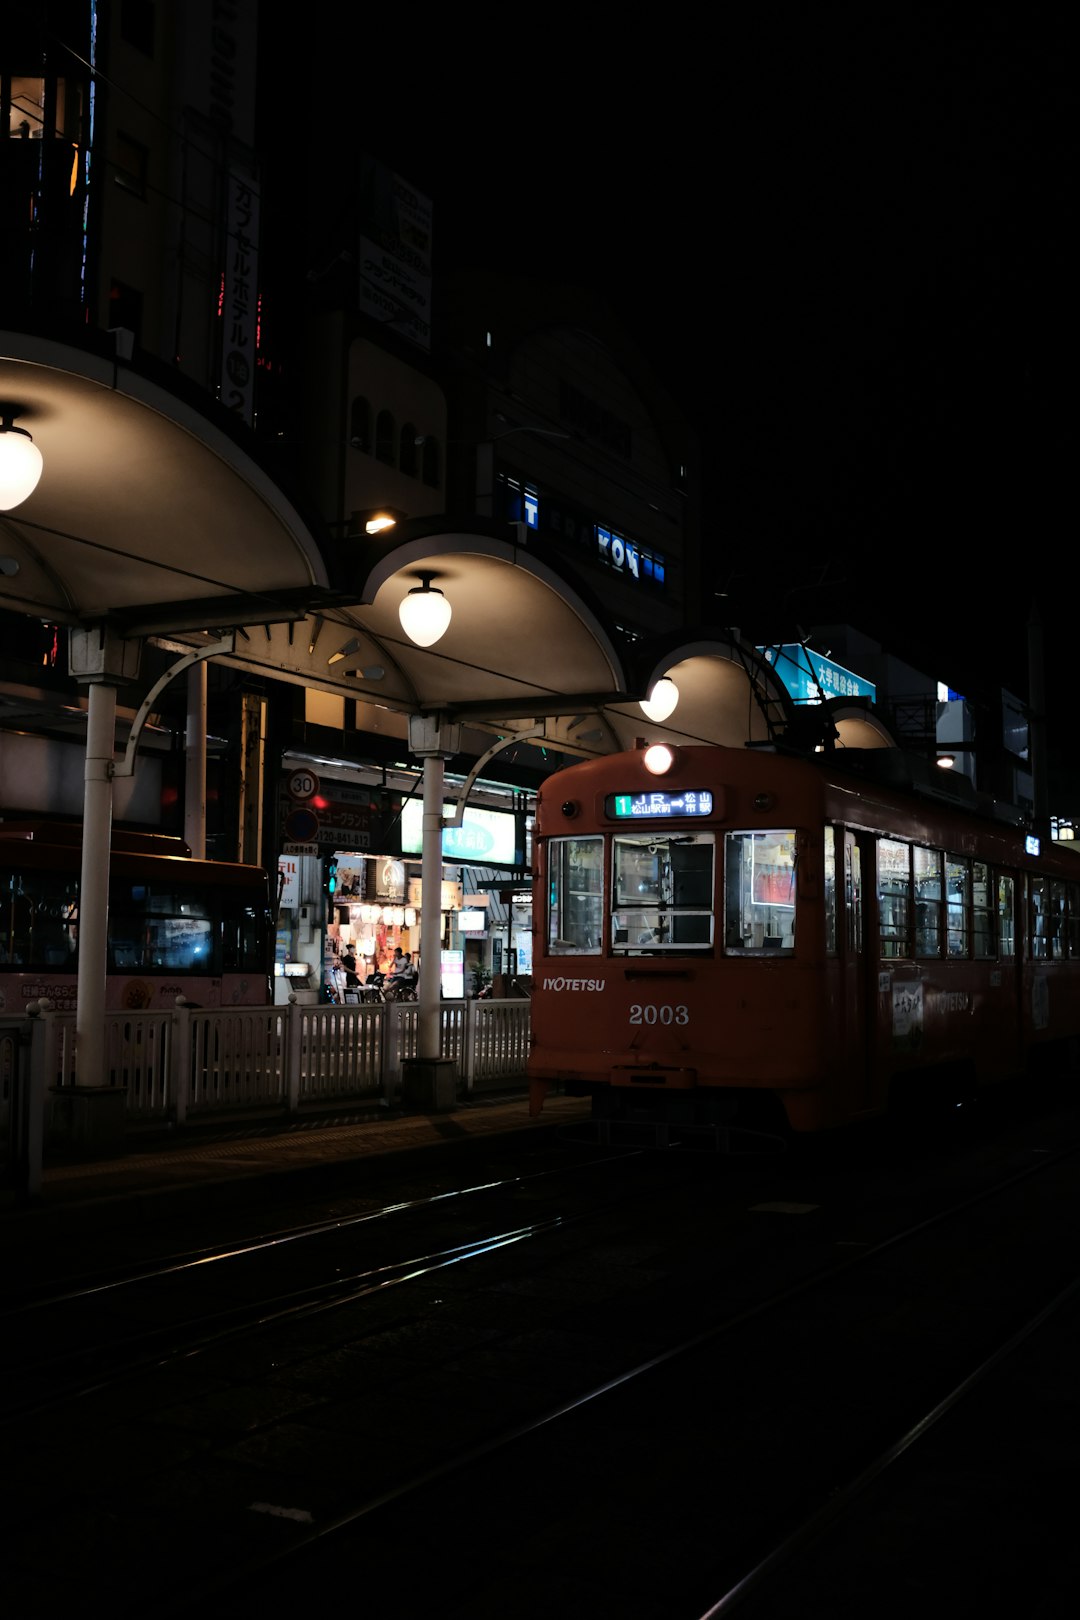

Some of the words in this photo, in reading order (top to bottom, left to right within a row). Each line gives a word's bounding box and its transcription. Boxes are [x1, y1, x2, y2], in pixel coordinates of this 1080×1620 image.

[230, 184, 252, 347] カプセルホテル
[293, 778, 312, 793] 30
[619, 798, 626, 814] 1
[635, 794, 665, 805] JR
[631, 803, 671, 814] 松山駅前
[319, 810, 368, 828] ニューグランド
[543, 976, 606, 992] IYOTETSU
[629, 1004, 690, 1025] 2003
